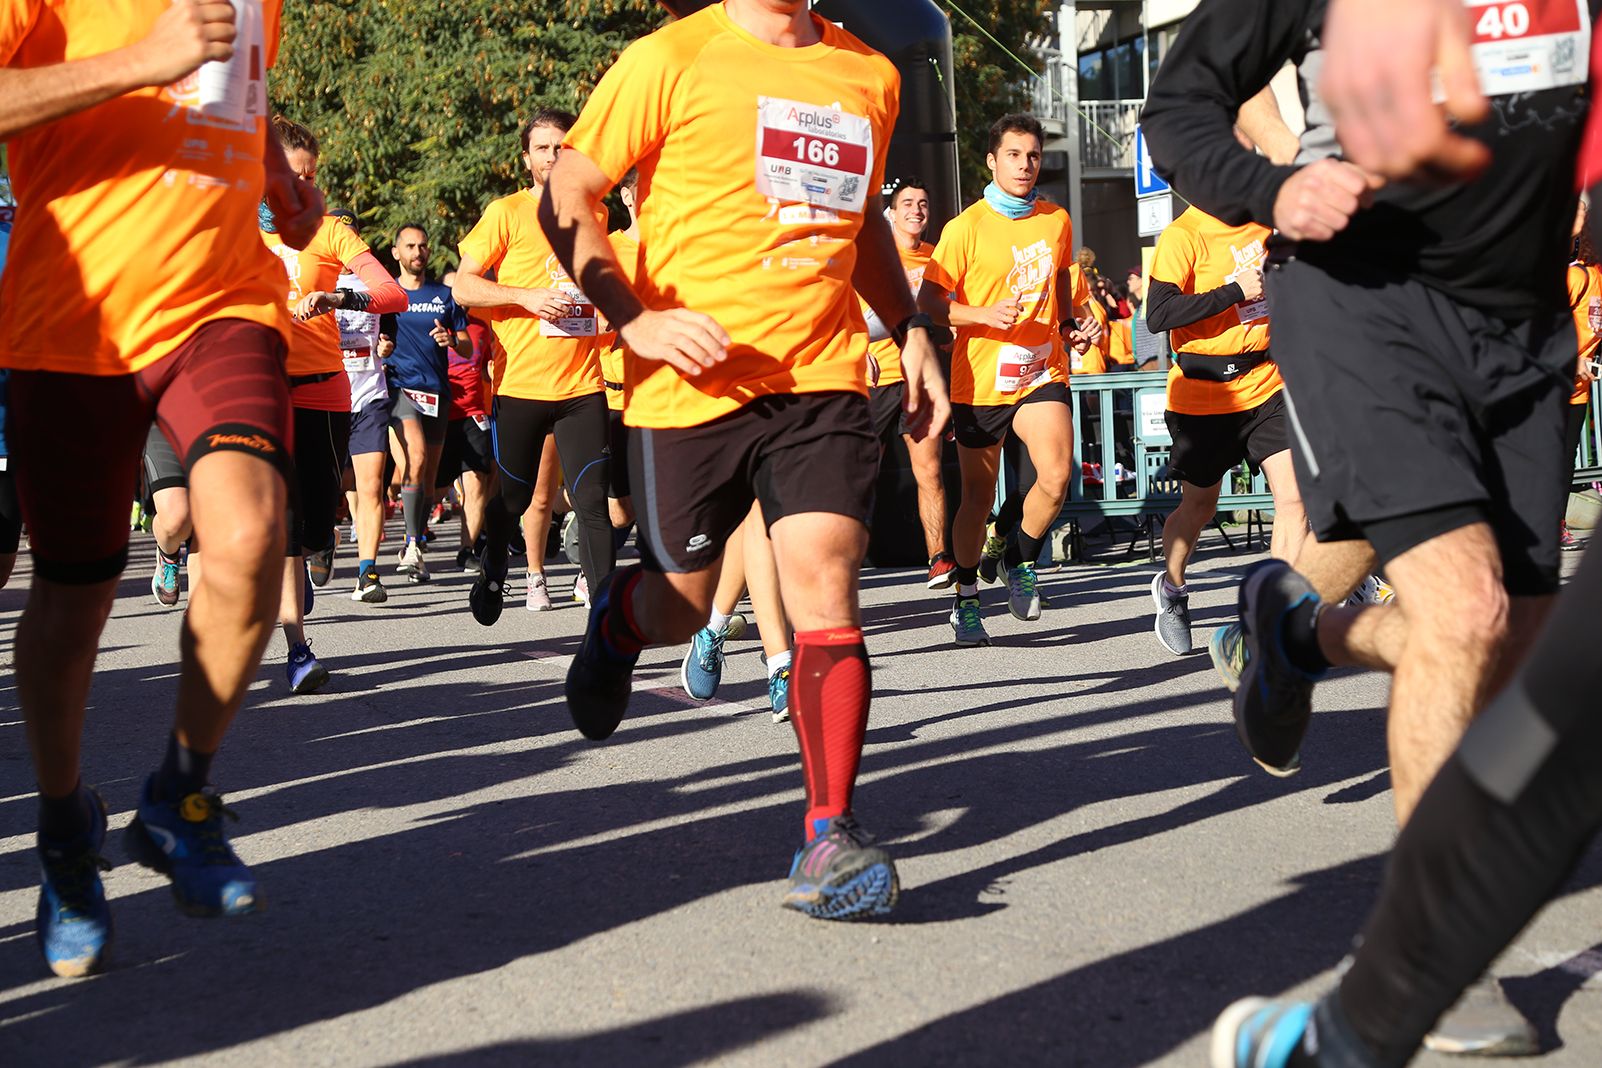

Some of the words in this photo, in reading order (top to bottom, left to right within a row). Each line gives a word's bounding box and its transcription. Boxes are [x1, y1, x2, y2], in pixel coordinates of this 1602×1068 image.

[1476, 3, 1530, 38] 40
[793, 137, 839, 166] 166
[410, 392, 428, 403] 134
